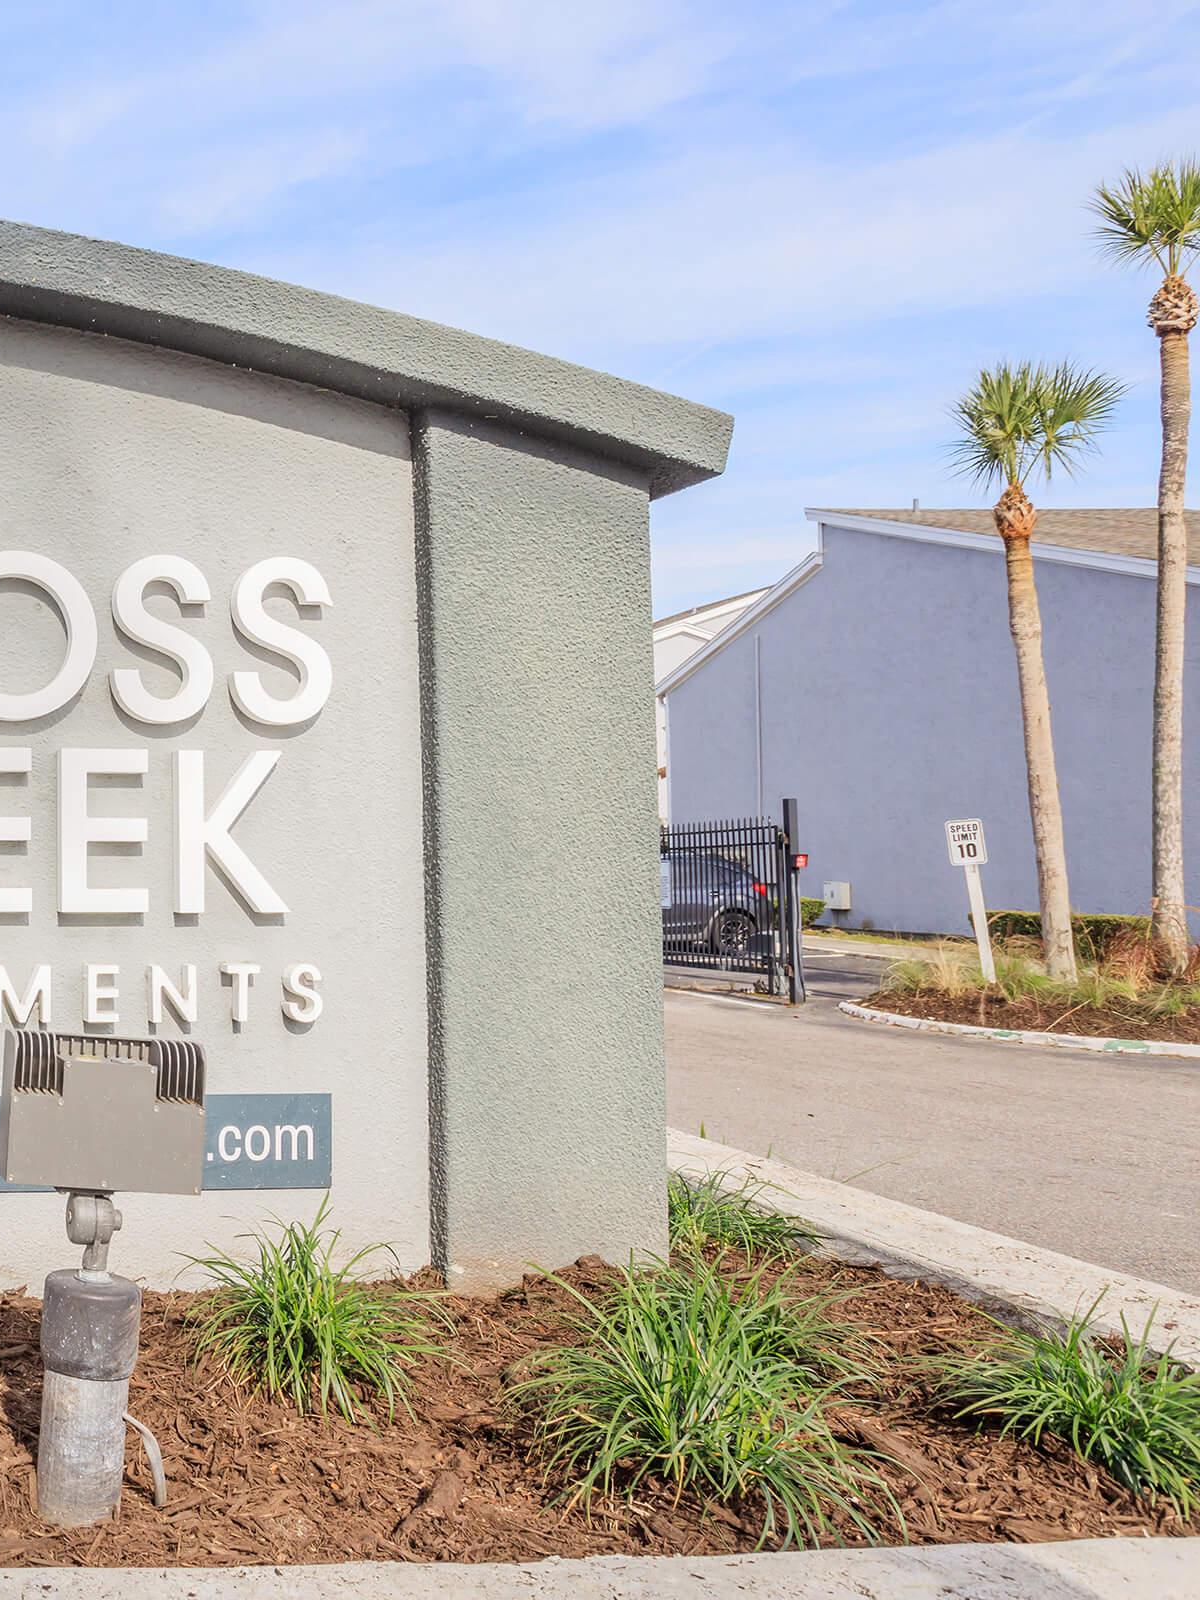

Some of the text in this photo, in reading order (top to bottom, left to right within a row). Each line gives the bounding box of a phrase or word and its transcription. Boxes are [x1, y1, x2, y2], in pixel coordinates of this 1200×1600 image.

[950, 823, 978, 833] SPEED
[952, 832, 977, 842] LIMIT
[957, 843, 977, 858] 10
